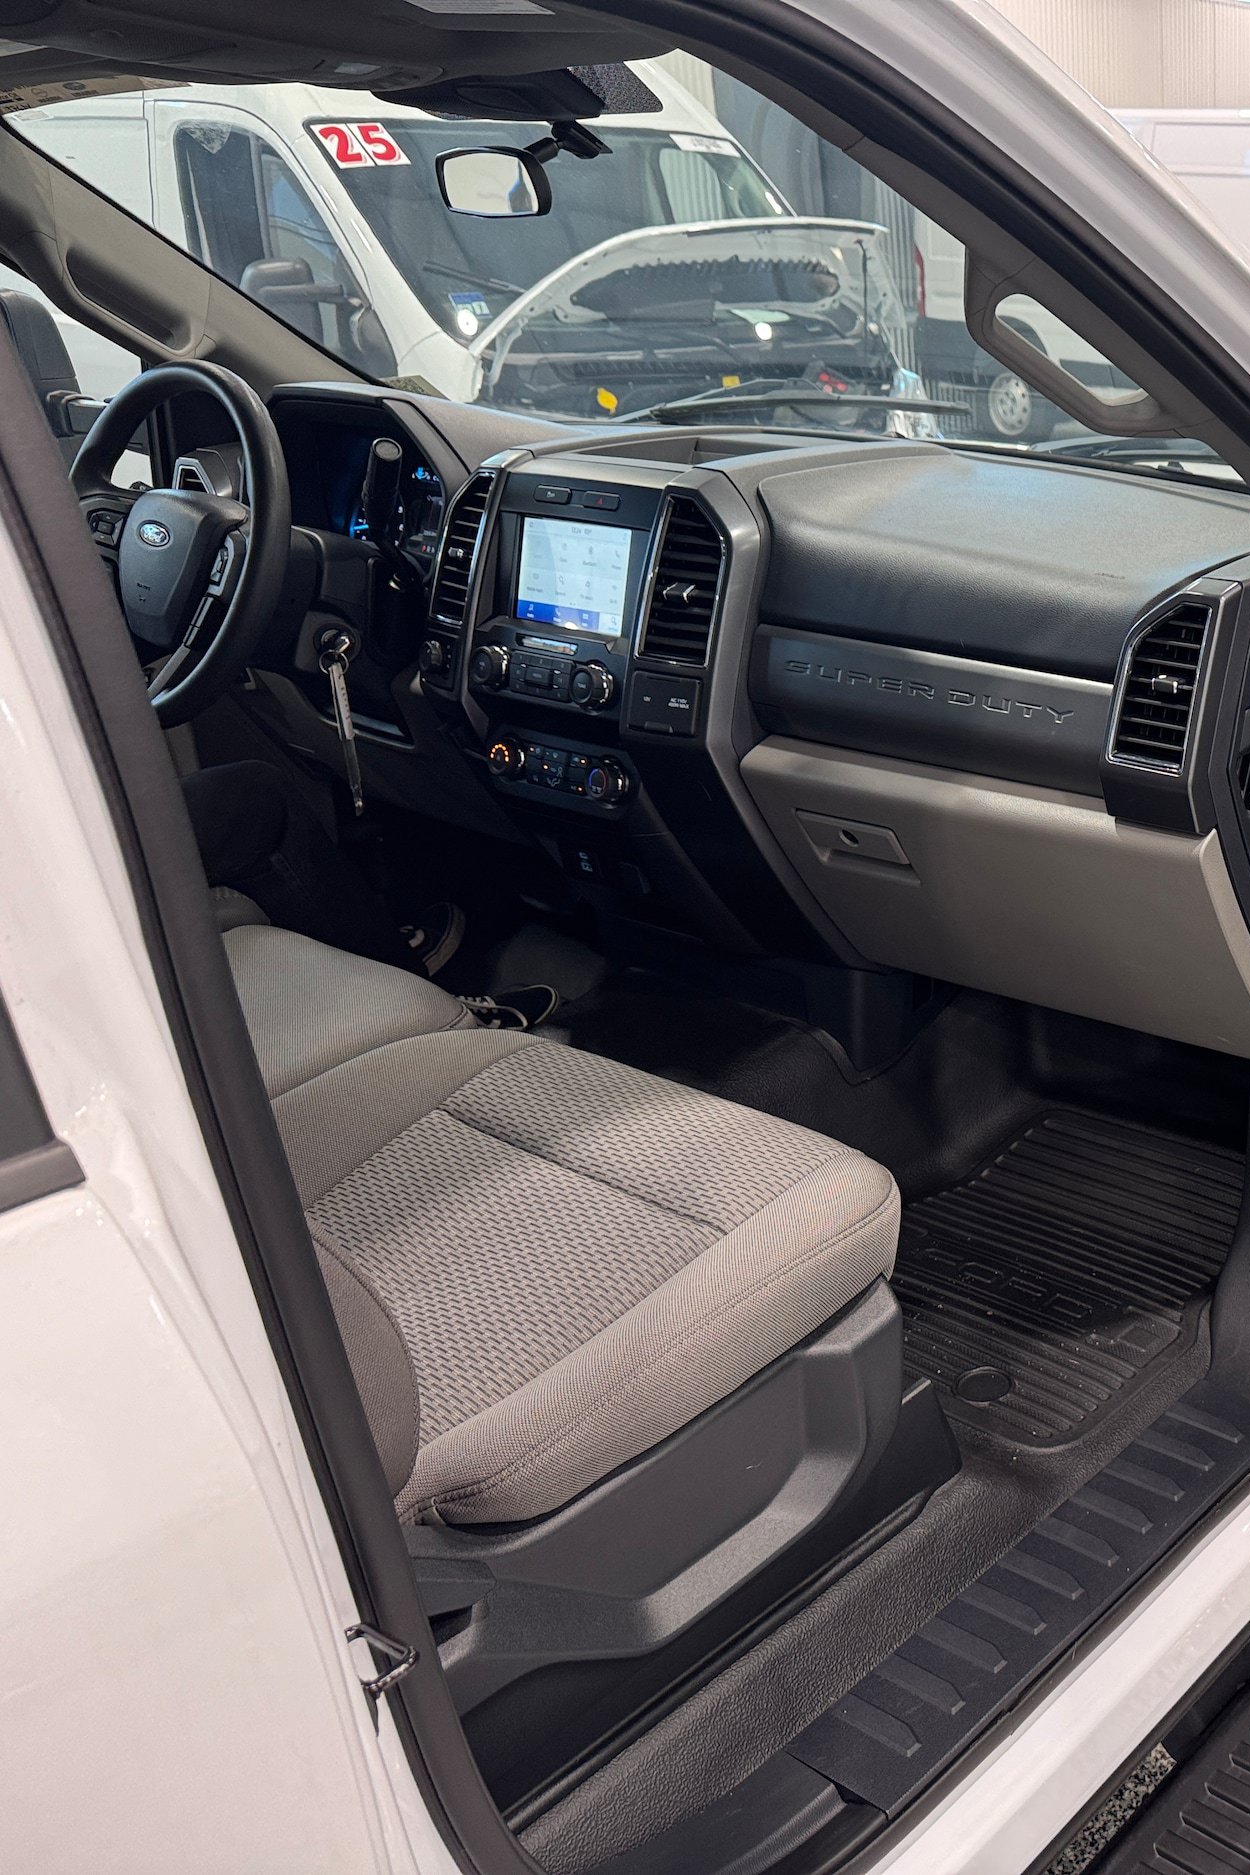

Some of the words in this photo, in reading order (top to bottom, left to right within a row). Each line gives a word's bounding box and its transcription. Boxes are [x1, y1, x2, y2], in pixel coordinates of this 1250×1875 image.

[317, 125, 400, 163] 25
[784, 660, 935, 699] SUPER
[948, 689, 1075, 724] DUTY
[911, 1246, 1094, 1320] FORD
